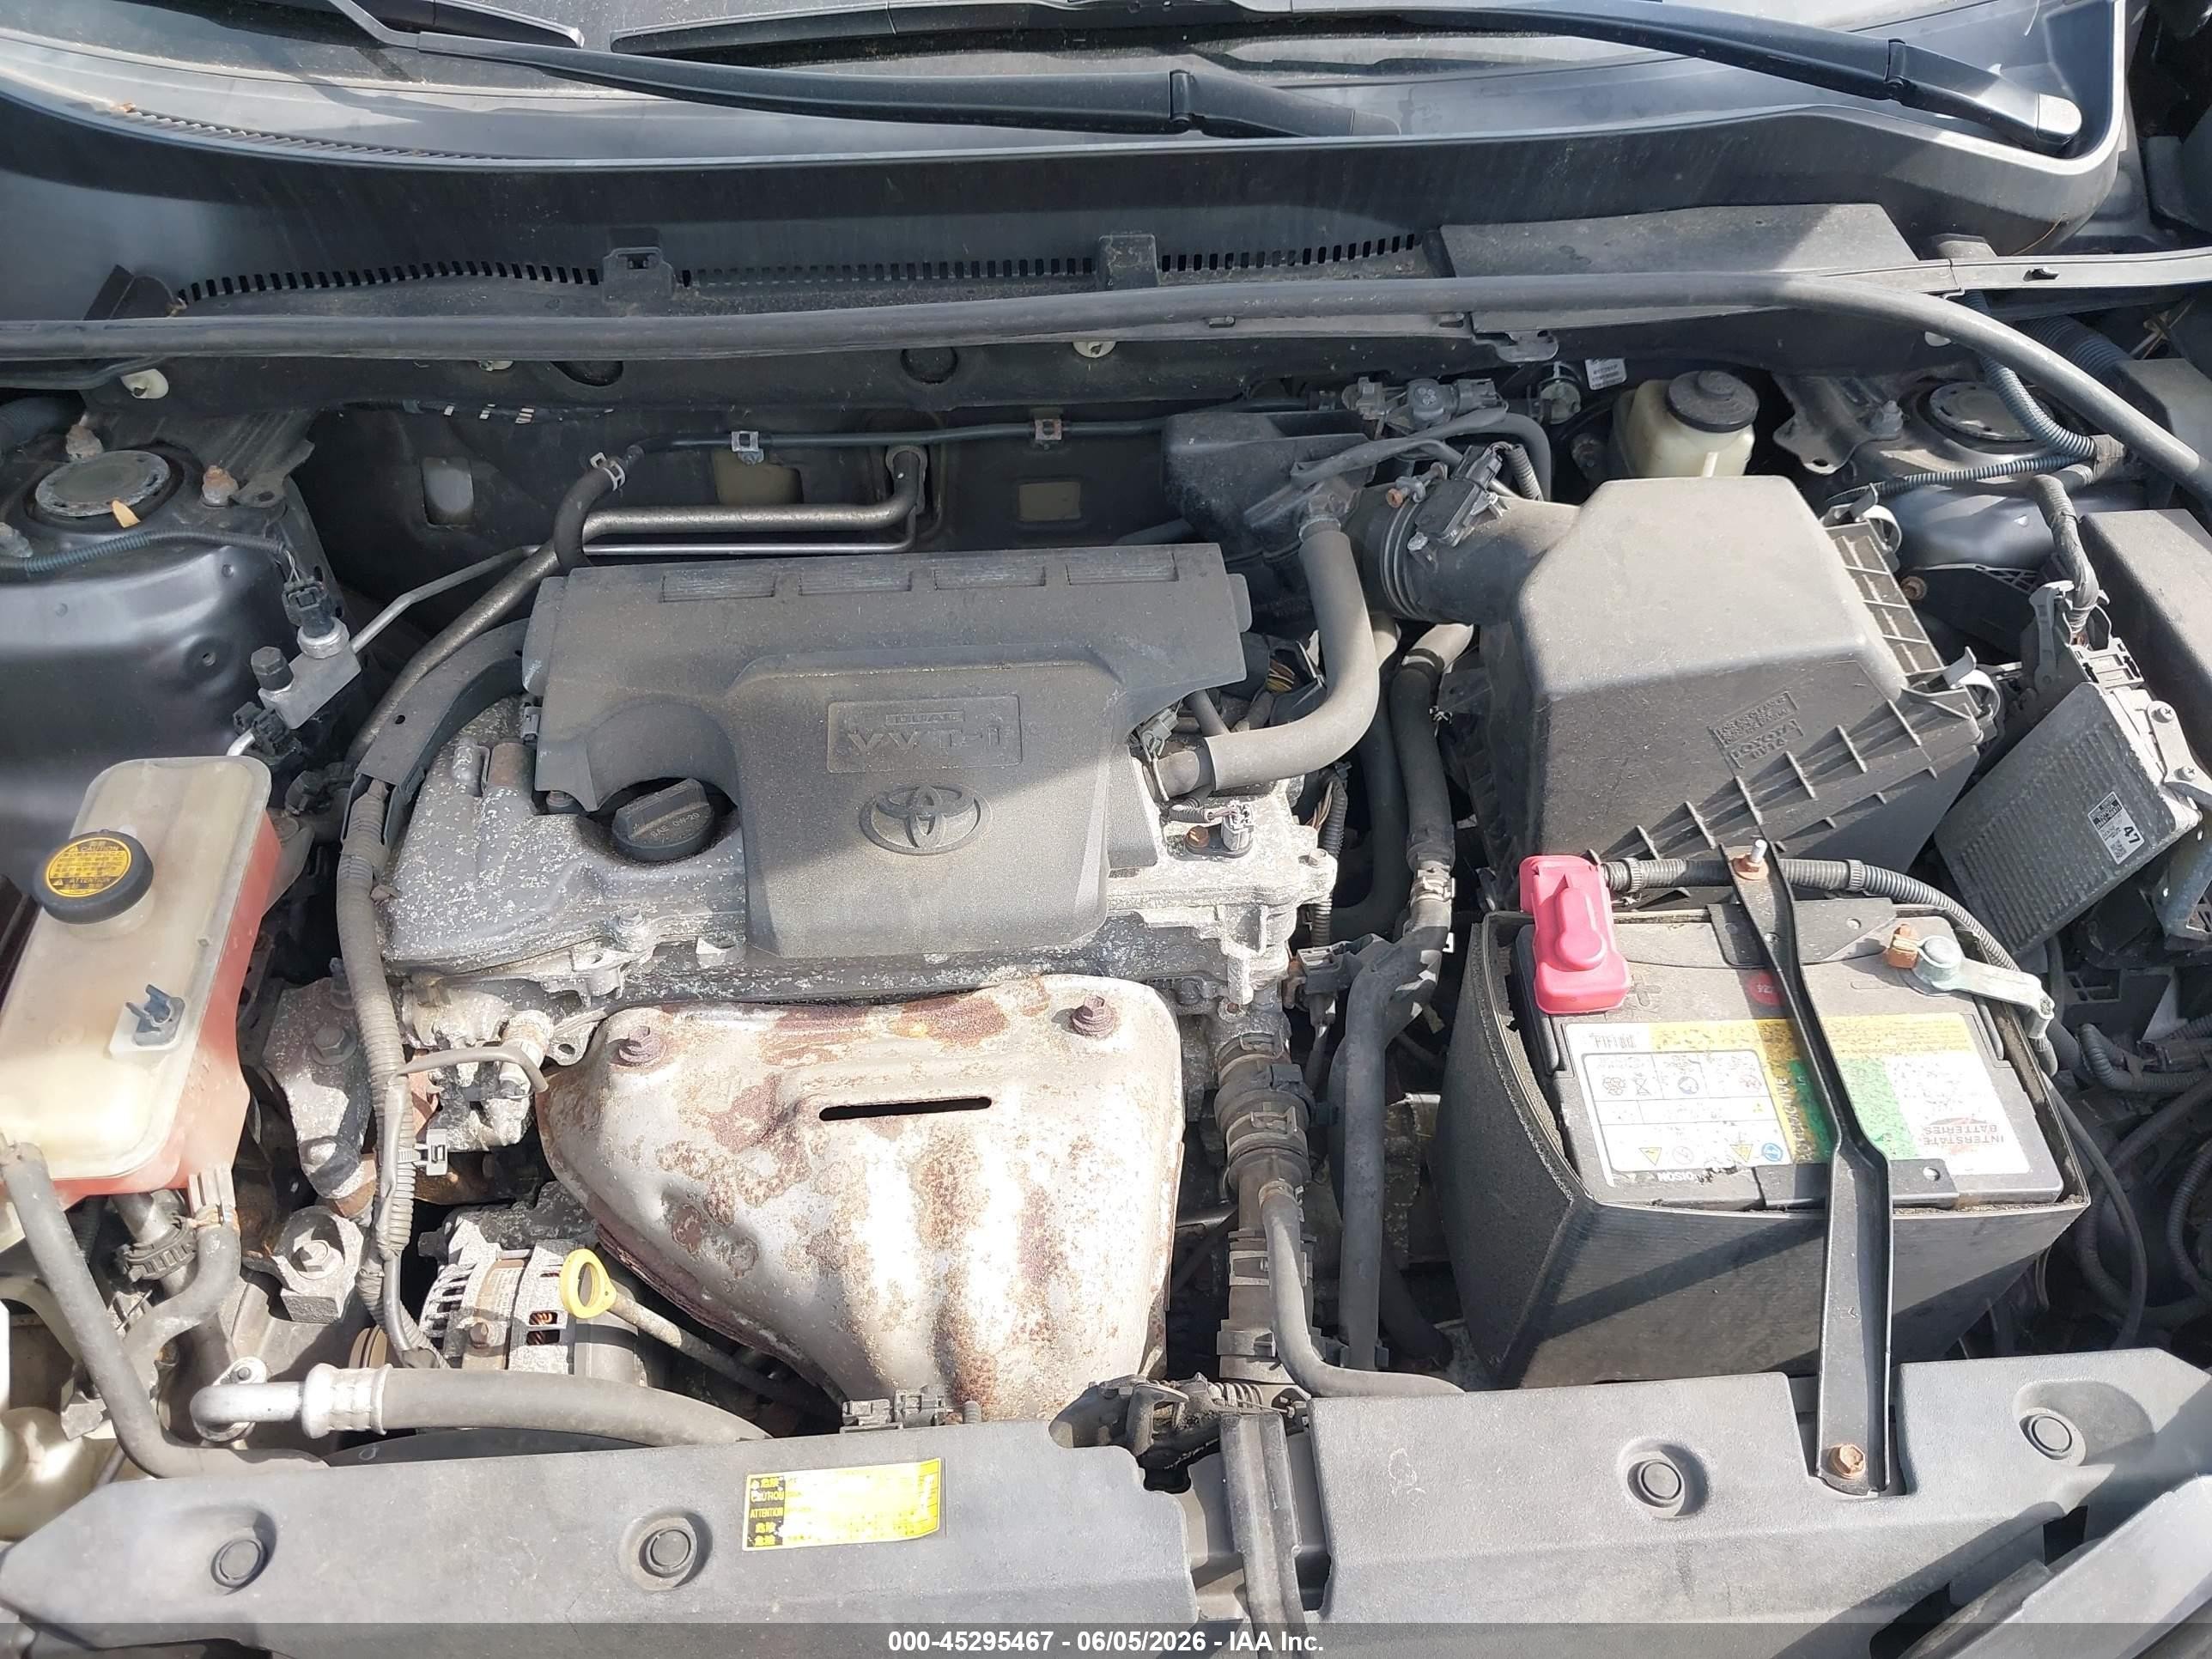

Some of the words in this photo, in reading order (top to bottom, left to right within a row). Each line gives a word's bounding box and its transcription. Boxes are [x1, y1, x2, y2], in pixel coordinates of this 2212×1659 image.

[1731, 719, 1796, 758] TOYOTA
[650, 824, 670, 837] SAE
[2124, 826, 2141, 844] 47
[1923, 1124, 1998, 1134] BATTERIES
[1923, 1135, 2005, 1146] INTERSTATE
[1657, 1170, 1702, 1182] OISON
[750, 1507, 785, 1518] ATTENTION
